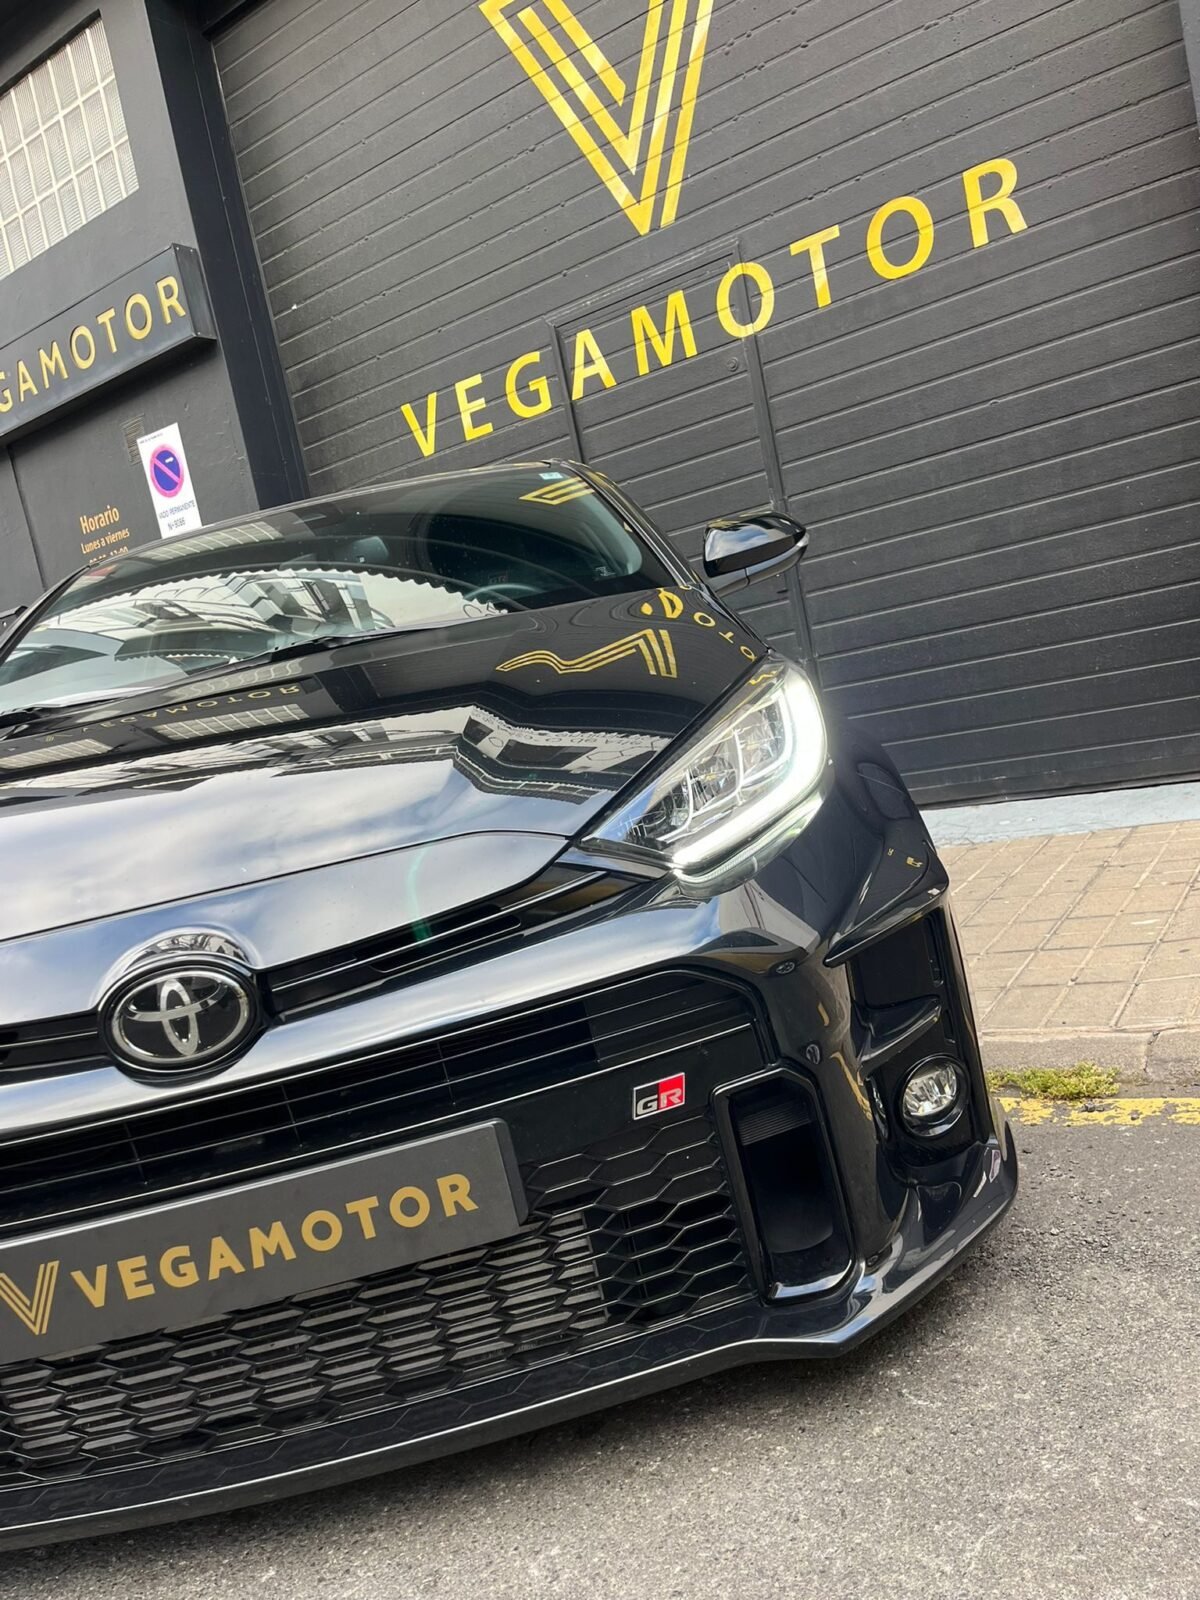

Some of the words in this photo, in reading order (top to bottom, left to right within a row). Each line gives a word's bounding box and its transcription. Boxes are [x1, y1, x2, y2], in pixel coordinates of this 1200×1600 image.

[401, 158, 1028, 457] VEGAMOTOR
[80, 505, 120, 535] Horario
[81, 538, 101, 554] Lunes
[101, 536, 106, 546] a
[105, 528, 130, 543] viernes
[636, 1086, 683, 1116] GR
[71, 1173, 479, 1309] VEGAMOTOR
